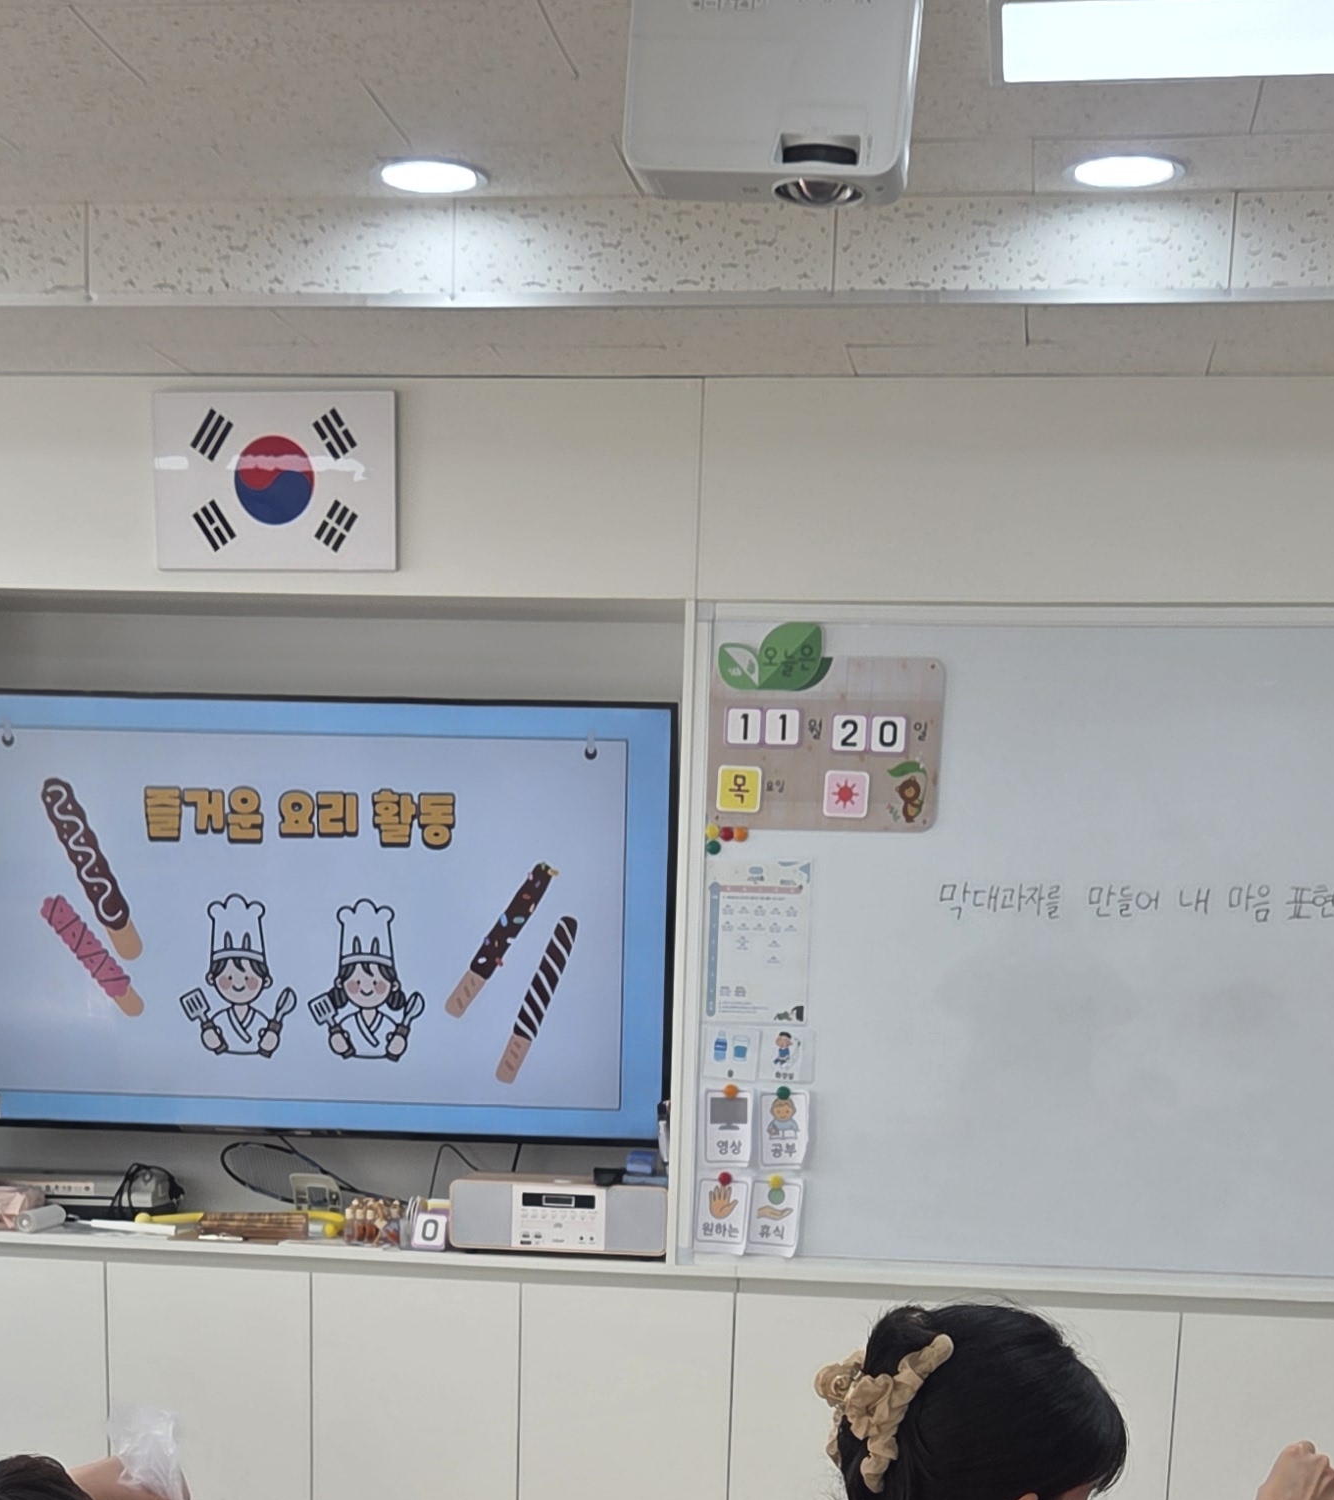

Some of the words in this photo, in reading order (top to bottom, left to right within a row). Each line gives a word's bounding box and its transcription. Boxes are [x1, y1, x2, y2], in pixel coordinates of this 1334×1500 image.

[762, 646, 816, 677] 오늘은
[840, 719, 898, 748] 20
[914, 721, 928, 742] 일
[728, 774, 750, 804] 목
[144, 785, 264, 844] 즐거운
[279, 789, 359, 838] 요리
[371, 788, 456, 850] 활동
[938, 882, 1061, 921] 막대과자를
[1087, 883, 1160, 919] 만들어
[1178, 887, 1210, 915] 내
[1228, 883, 1271, 923] 마음
[716, 1139, 743, 1156] 영상
[770, 1142, 797, 1158] 공부
[421, 1218, 439, 1241] 0
[701, 1221, 740, 1239] 원하는
[758, 1224, 785, 1240] 휴식
